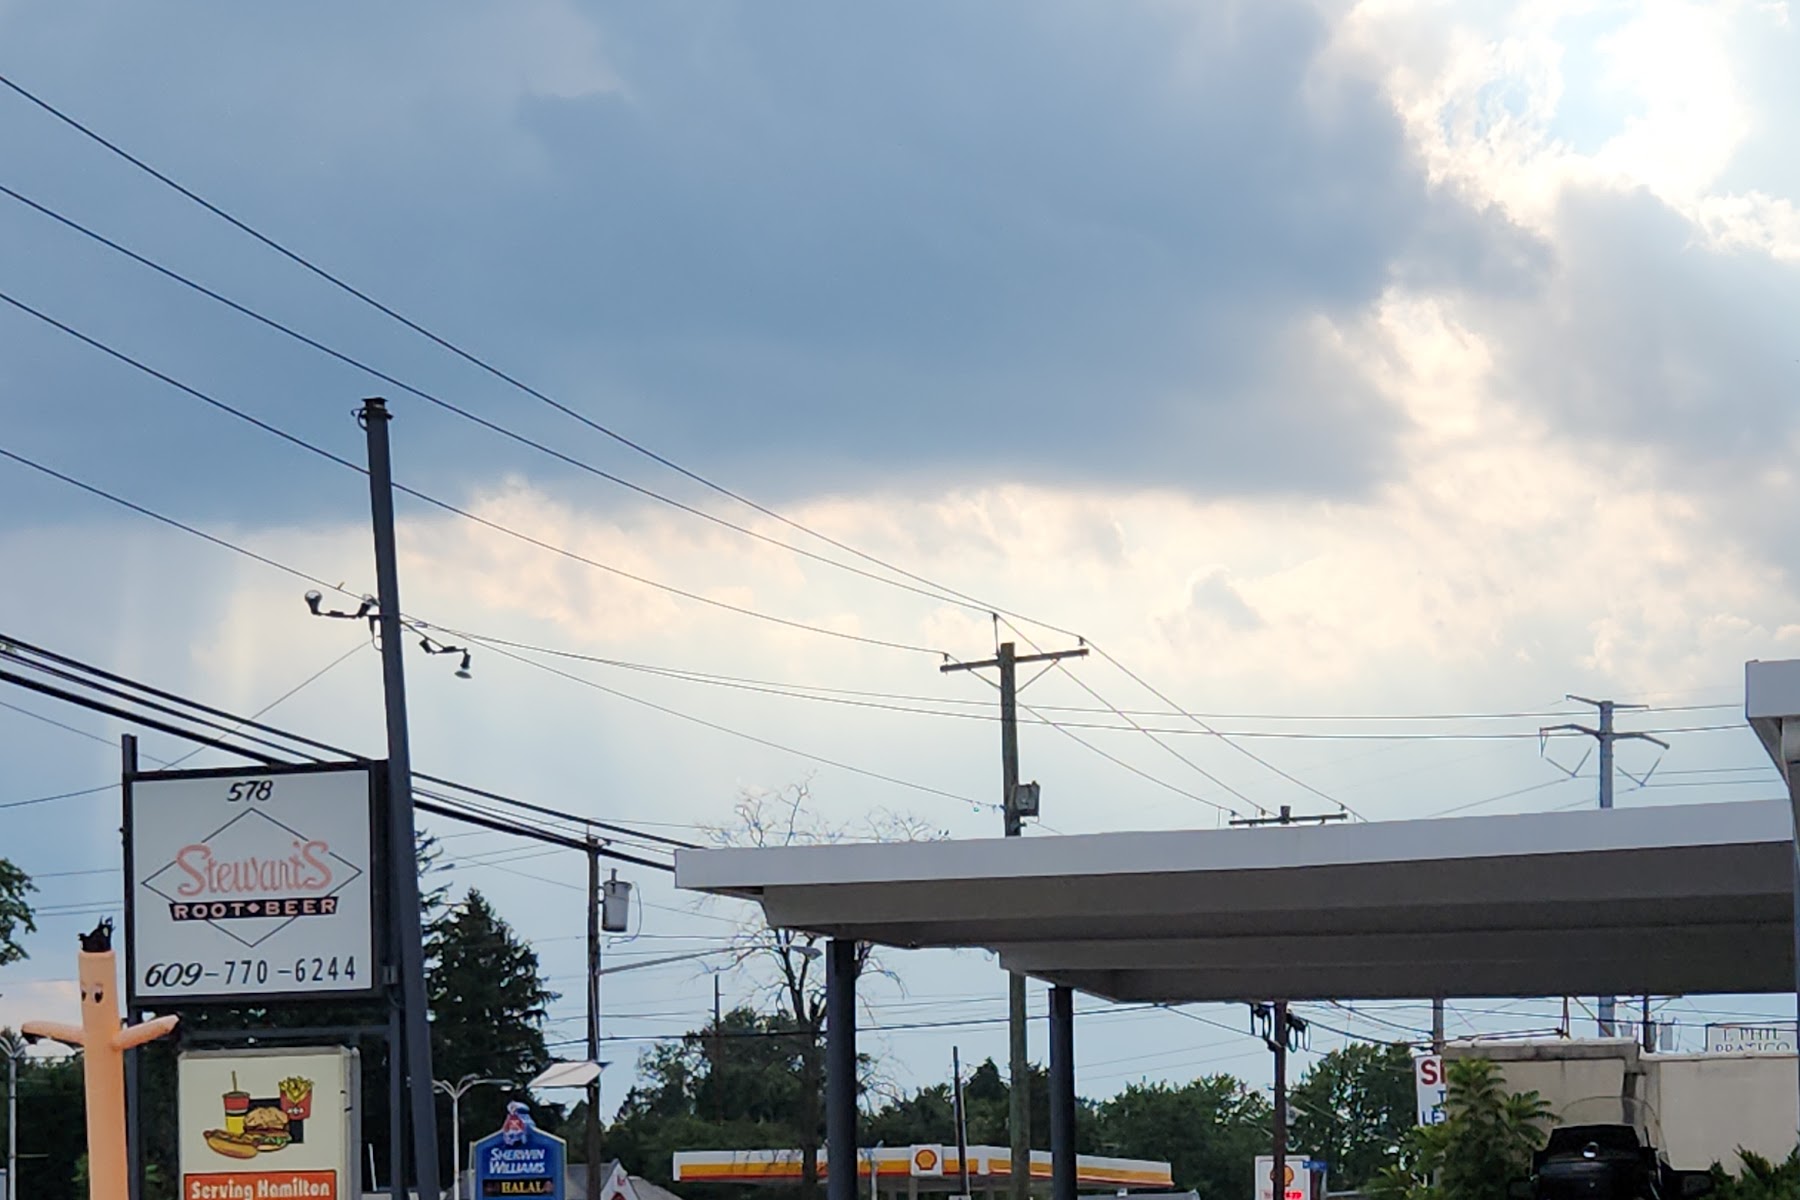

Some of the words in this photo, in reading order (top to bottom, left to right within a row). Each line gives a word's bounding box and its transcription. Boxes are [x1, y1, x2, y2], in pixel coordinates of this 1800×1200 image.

[227, 780, 273, 802] 578
[173, 903, 245, 920] ROOT
[265, 899, 336, 916] BEER
[490, 1148, 546, 1161] SHERWIN
[489, 1161, 546, 1174] WILLIAMS
[257, 1176, 330, 1198] Hamilton
